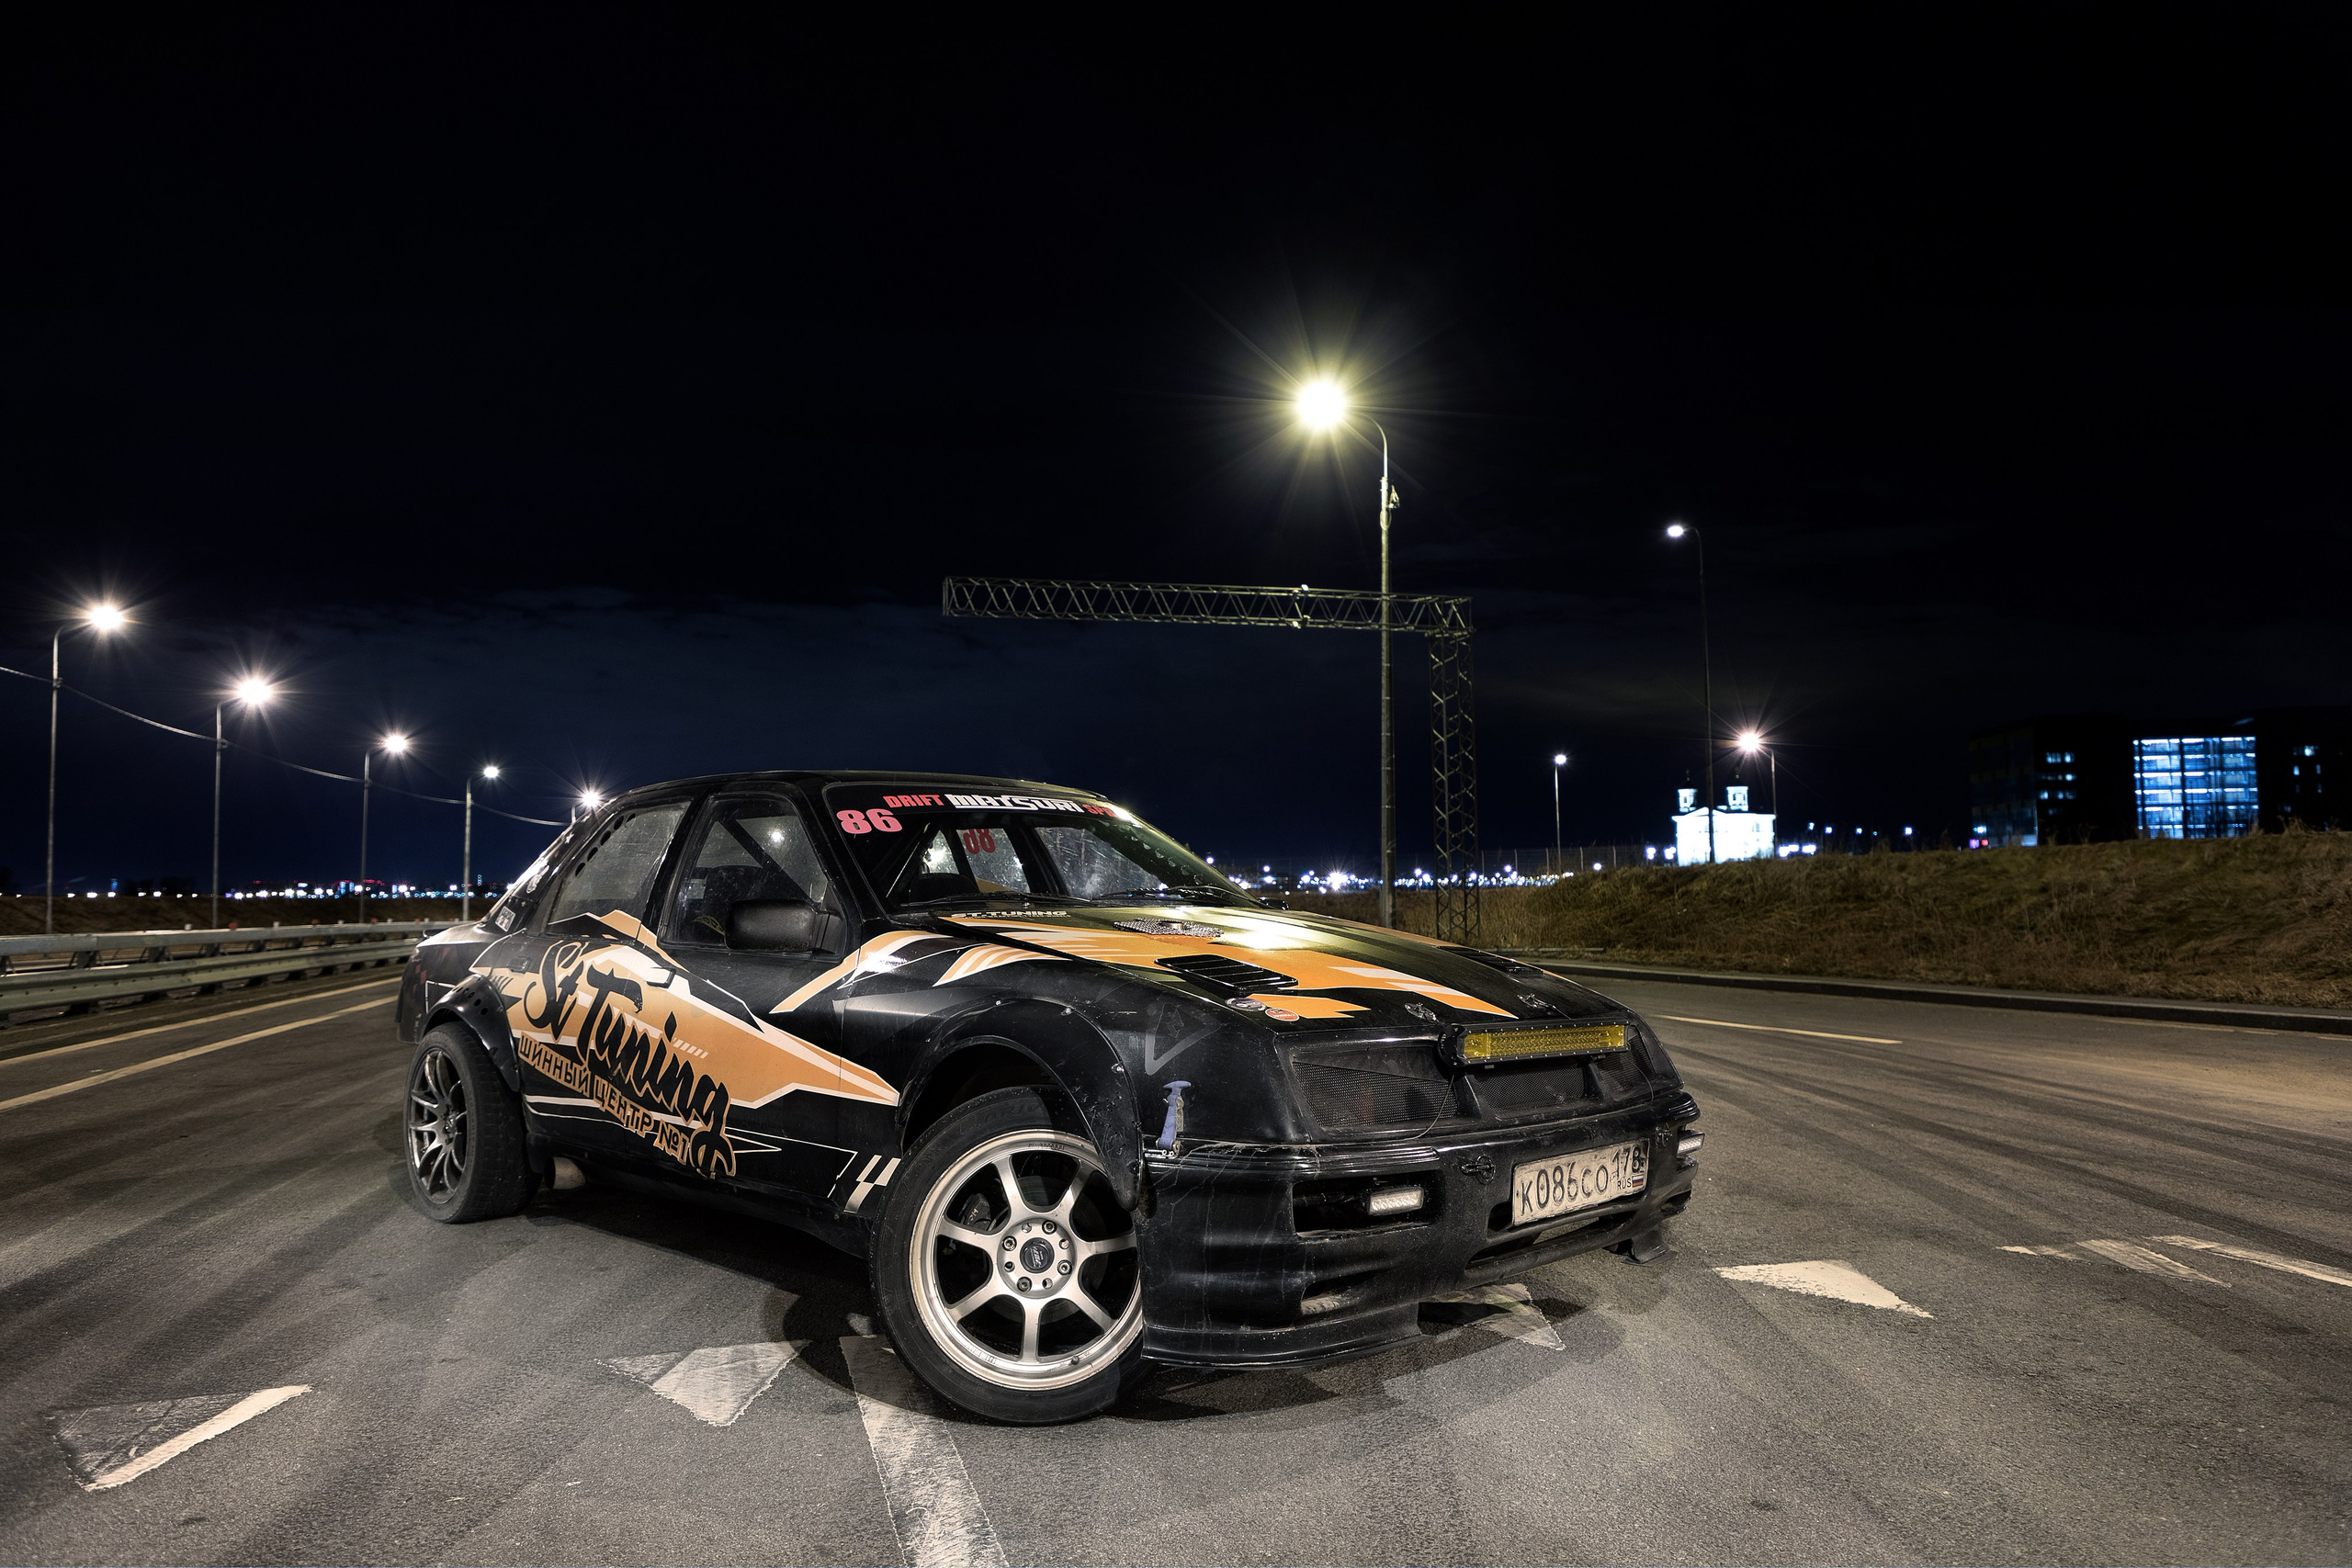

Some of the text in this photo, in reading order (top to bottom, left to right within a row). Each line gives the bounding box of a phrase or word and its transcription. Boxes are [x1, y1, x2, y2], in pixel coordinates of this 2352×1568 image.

[883, 795, 944, 808] DRIFT
[944, 794, 1085, 813] MATSURI
[836, 808, 903, 834] 86
[577, 964, 735, 1179] Tuning
[518, 1032, 689, 1165] ШИННЫЙ ЦЕНТР №1
[1617, 1178, 1632, 1190] RUS
